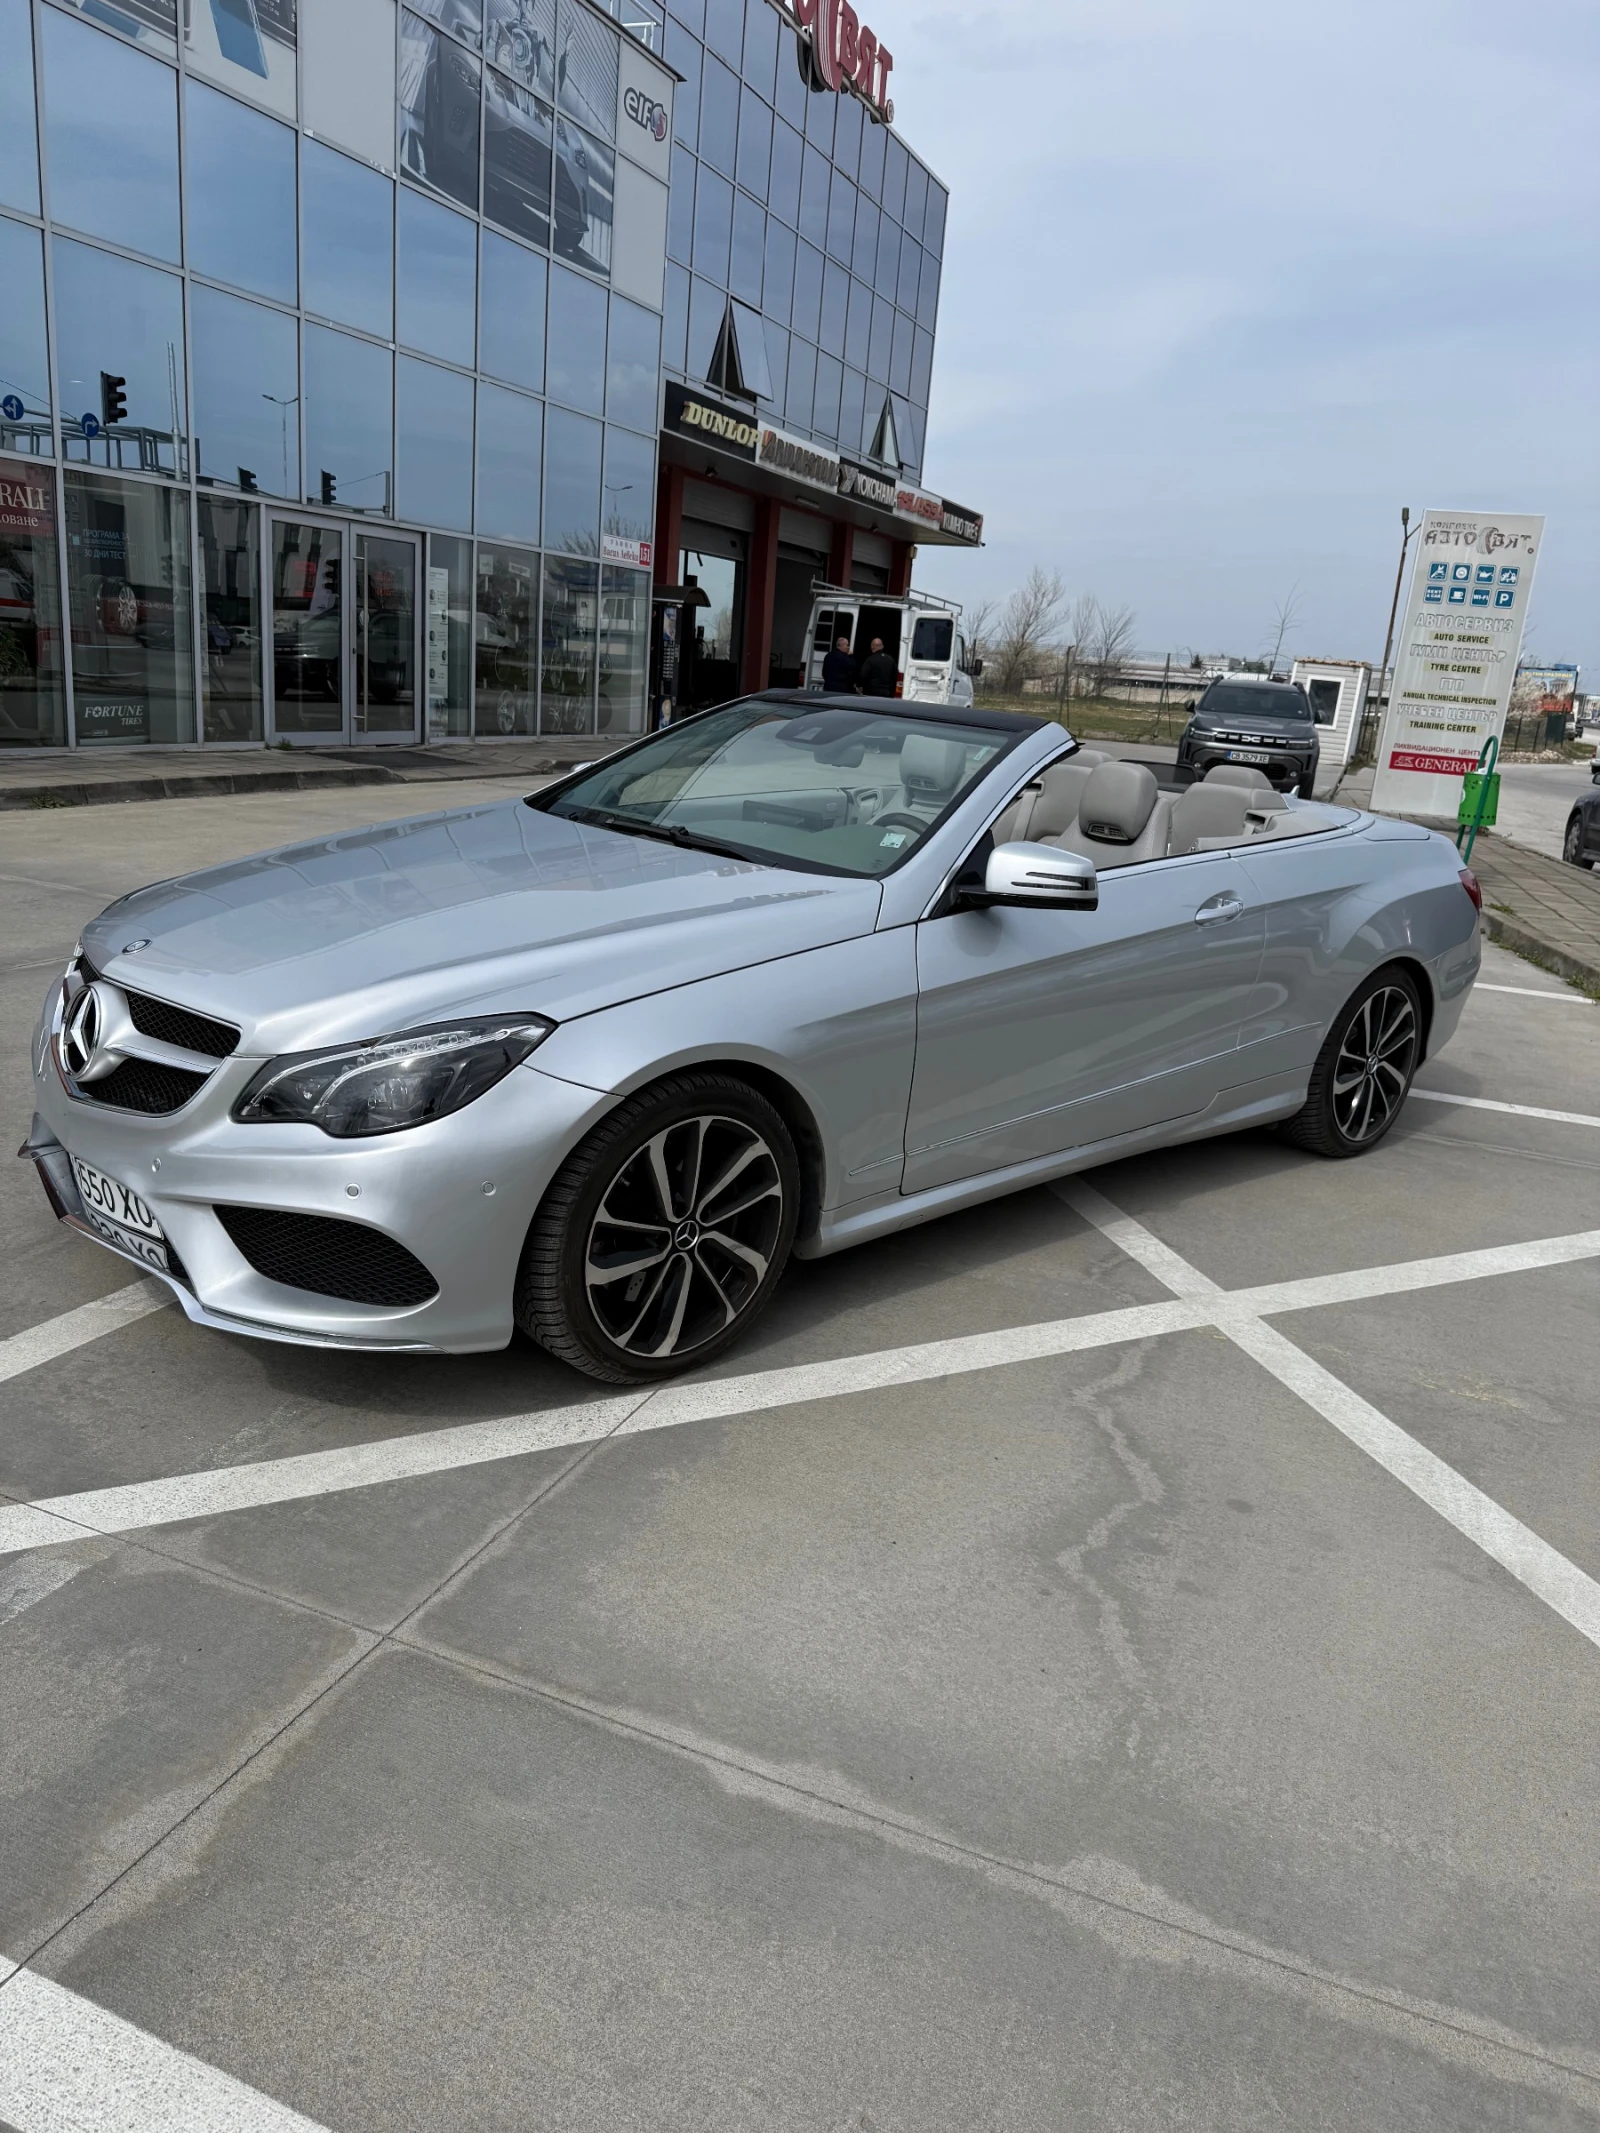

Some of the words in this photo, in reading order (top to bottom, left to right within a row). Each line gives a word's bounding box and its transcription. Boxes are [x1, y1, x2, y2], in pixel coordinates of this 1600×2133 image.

[624, 87, 655, 131] elf
[682, 401, 763, 448] DUNLOP
[857, 473, 898, 508] YOKOHAMA
[943, 511, 965, 536] KUMHO
[93, 550, 109, 560] ДНИ
[110, 550, 126, 560] ТЕСТ
[640, 547, 650, 562] 151
[1414, 612, 1514, 633] АВТОСЕРВИЗ
[1434, 633, 1454, 641] AUTO
[1456, 634, 1490, 644] SERVICE
[1410, 643, 1448, 659] ГУМИ
[1452, 647, 1507, 664] ЦЕНТЪР
[1430, 663, 1449, 672] TYRE
[1451, 664, 1482, 674] CENTRE
[1439, 677, 1465, 691] ГТП
[1402, 691, 1426, 700] ANNUAL
[1427, 693, 1460, 703] TECHNICAL
[1460, 696, 1497, 706] INSPECTION
[84, 705, 144, 718] FORTUNE
[1397, 703, 1445, 718] УЧЕБЕН
[1447, 707, 1498, 722] ЦЕНТЪР
[121, 717, 142, 726] TIRES
[1409, 720, 1445, 731] TRAINING
[1446, 723, 1477, 733] CENTER
[1393, 742, 1456, 754] ЛИКВИДАЦИОНЕН
[1241, 753, 1257, 762] 3579
